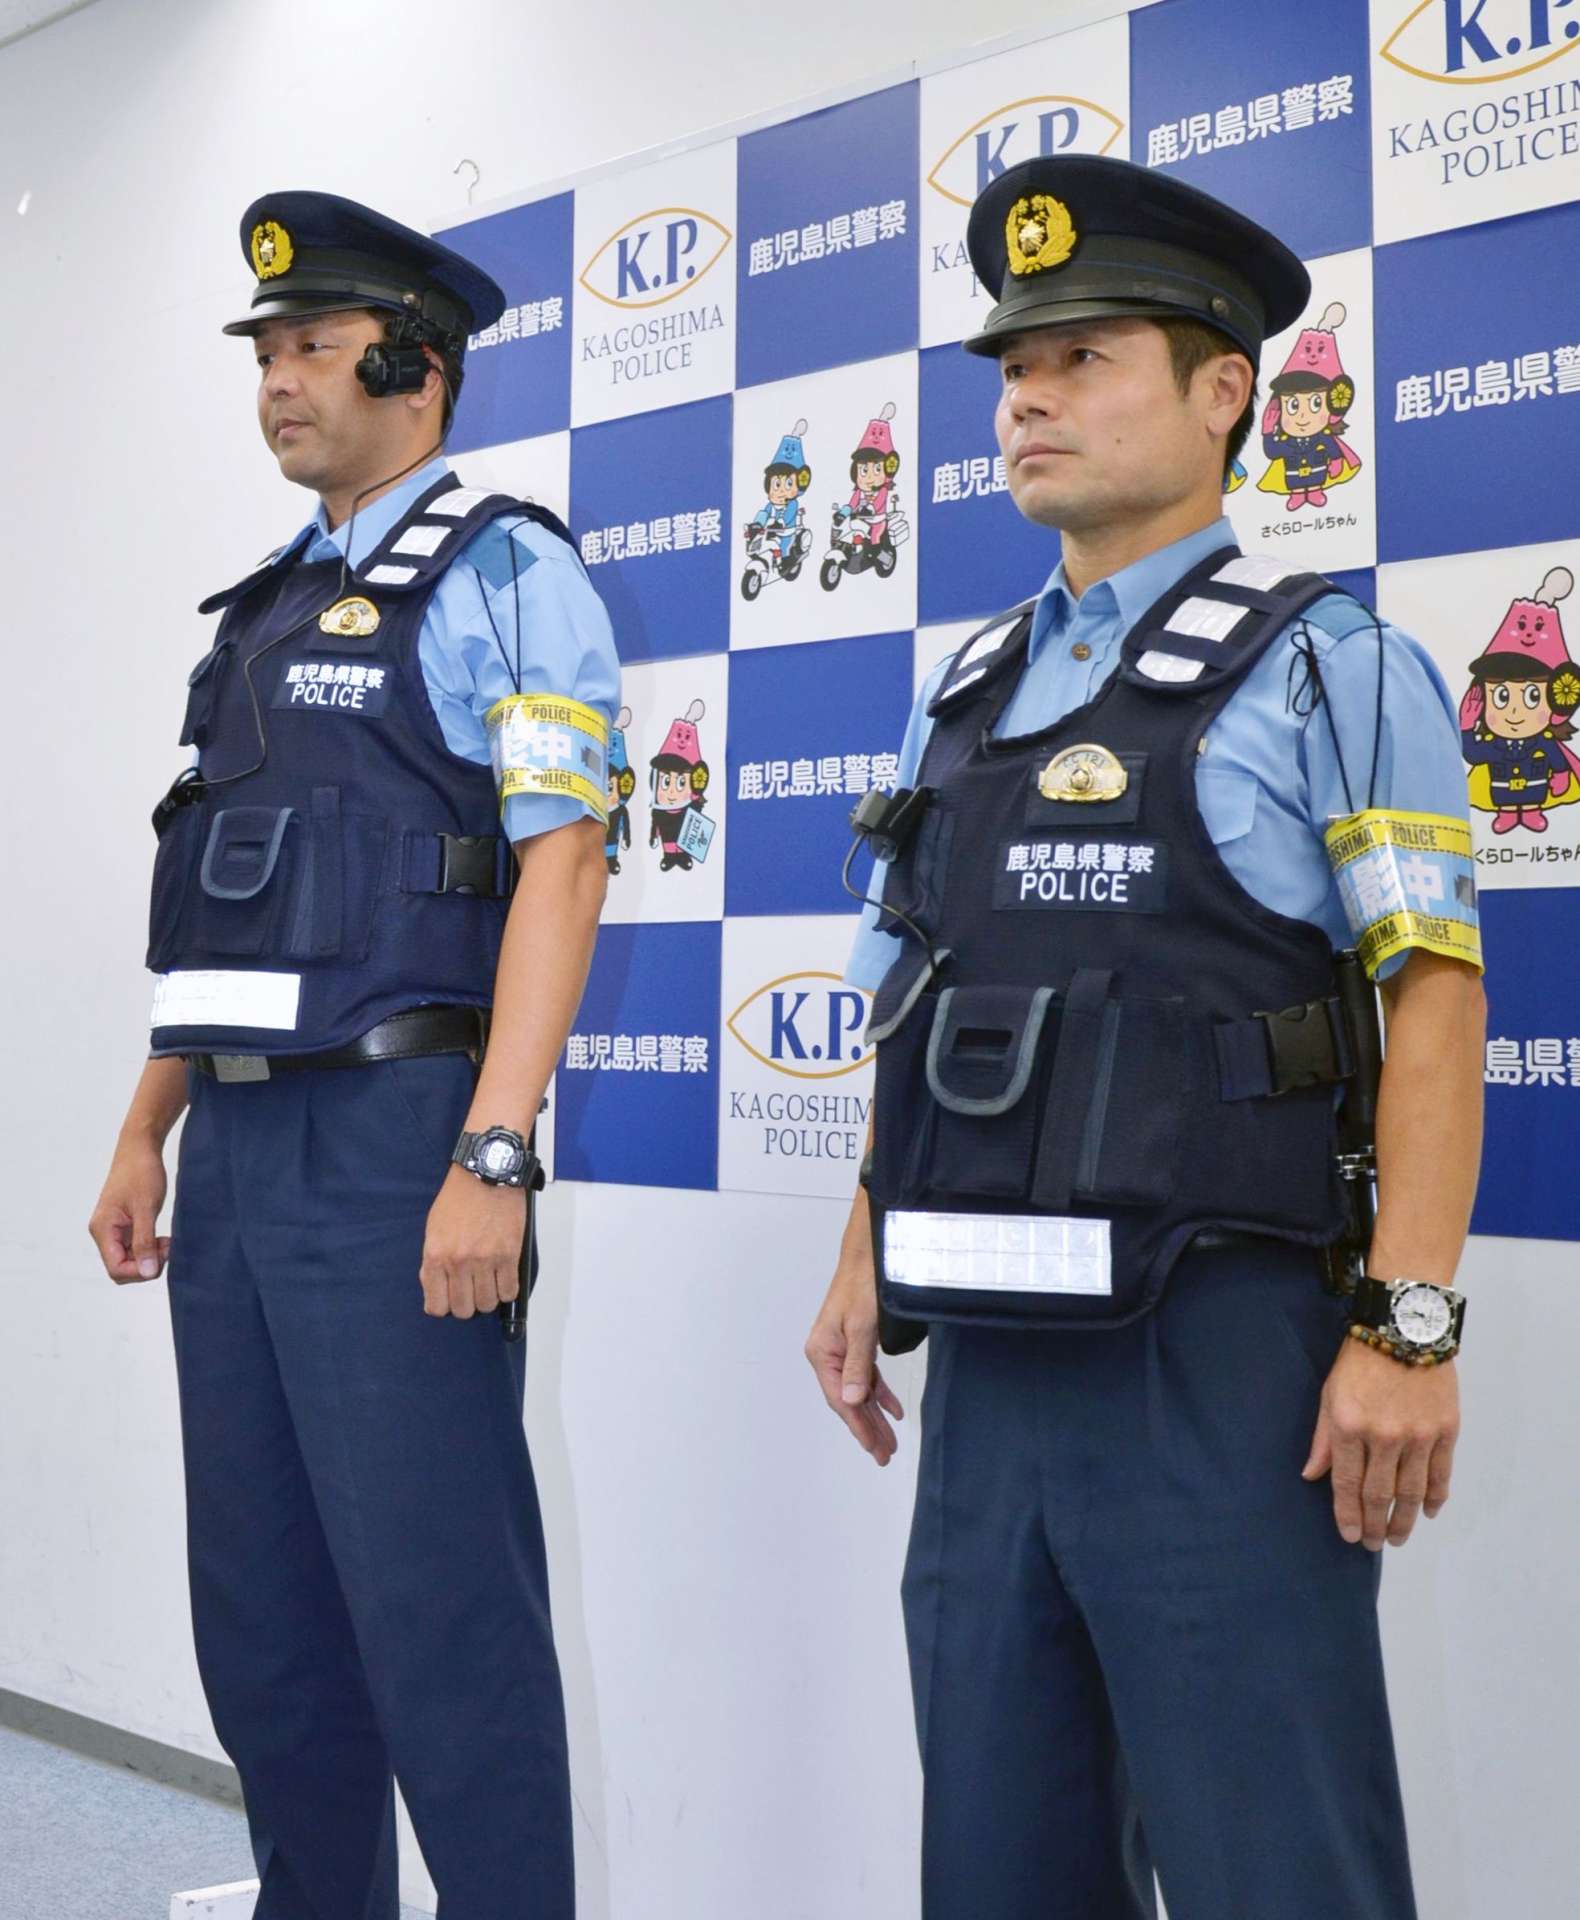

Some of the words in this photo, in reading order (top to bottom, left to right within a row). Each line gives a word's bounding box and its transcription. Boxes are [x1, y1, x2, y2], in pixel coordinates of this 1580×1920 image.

[1147, 75, 1353, 167] 鹿児島県警察
[1441, 122, 1580, 184] POLICE
[748, 200, 907, 276] 鹿児島県警察
[616, 218, 697, 299] K.P.
[581, 304, 725, 362] KAGOSHIMA
[611, 342, 693, 384] POLICE
[581, 508, 721, 566] 鹿児島県警察
[1261, 513, 1357, 538] さくらロールちゃん
[285, 664, 385, 689] 鹿児島県警察
[290, 683, 367, 709] POLICE
[531, 706, 571, 723] POLICE
[737, 752, 899, 800] 鹿児島県警察
[1391, 825, 1437, 847] POLICE
[1006, 843, 1155, 873] 鹿児島県警察
[1020, 871, 1130, 902] POLICE
[769, 991, 865, 1061] K.P.
[565, 1033, 709, 1073] 鹿児島県警察
[729, 1091, 872, 1126] KAGOSHIM
[764, 1127, 857, 1160] POLICE
